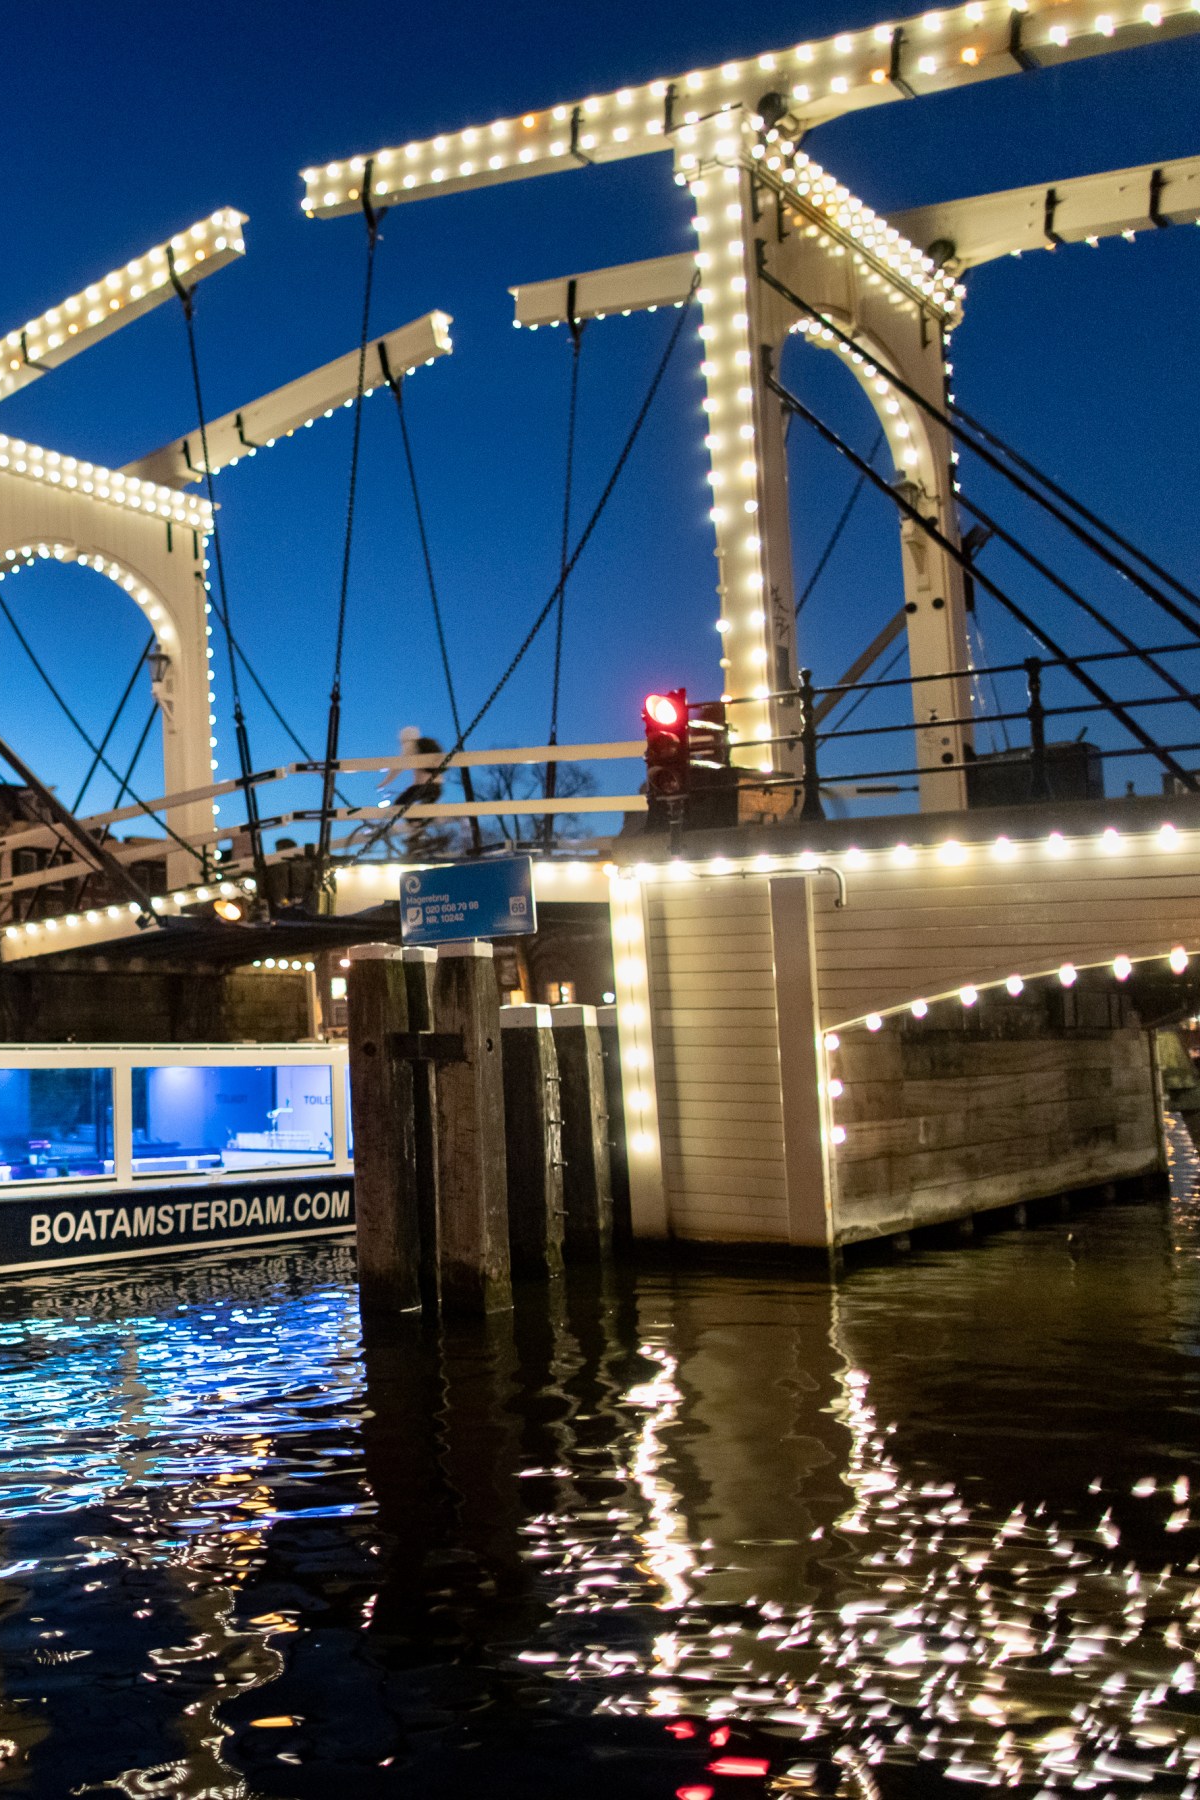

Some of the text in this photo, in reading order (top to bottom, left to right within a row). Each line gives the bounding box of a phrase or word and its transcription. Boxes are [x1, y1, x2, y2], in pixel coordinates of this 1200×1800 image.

[406, 894, 449, 905] Magerebrug
[425, 904, 440, 914] 020
[441, 903, 456, 913] 608
[511, 902, 525, 913] 69
[30, 1190, 349, 1246] BOATAMSTERDAM.COM
